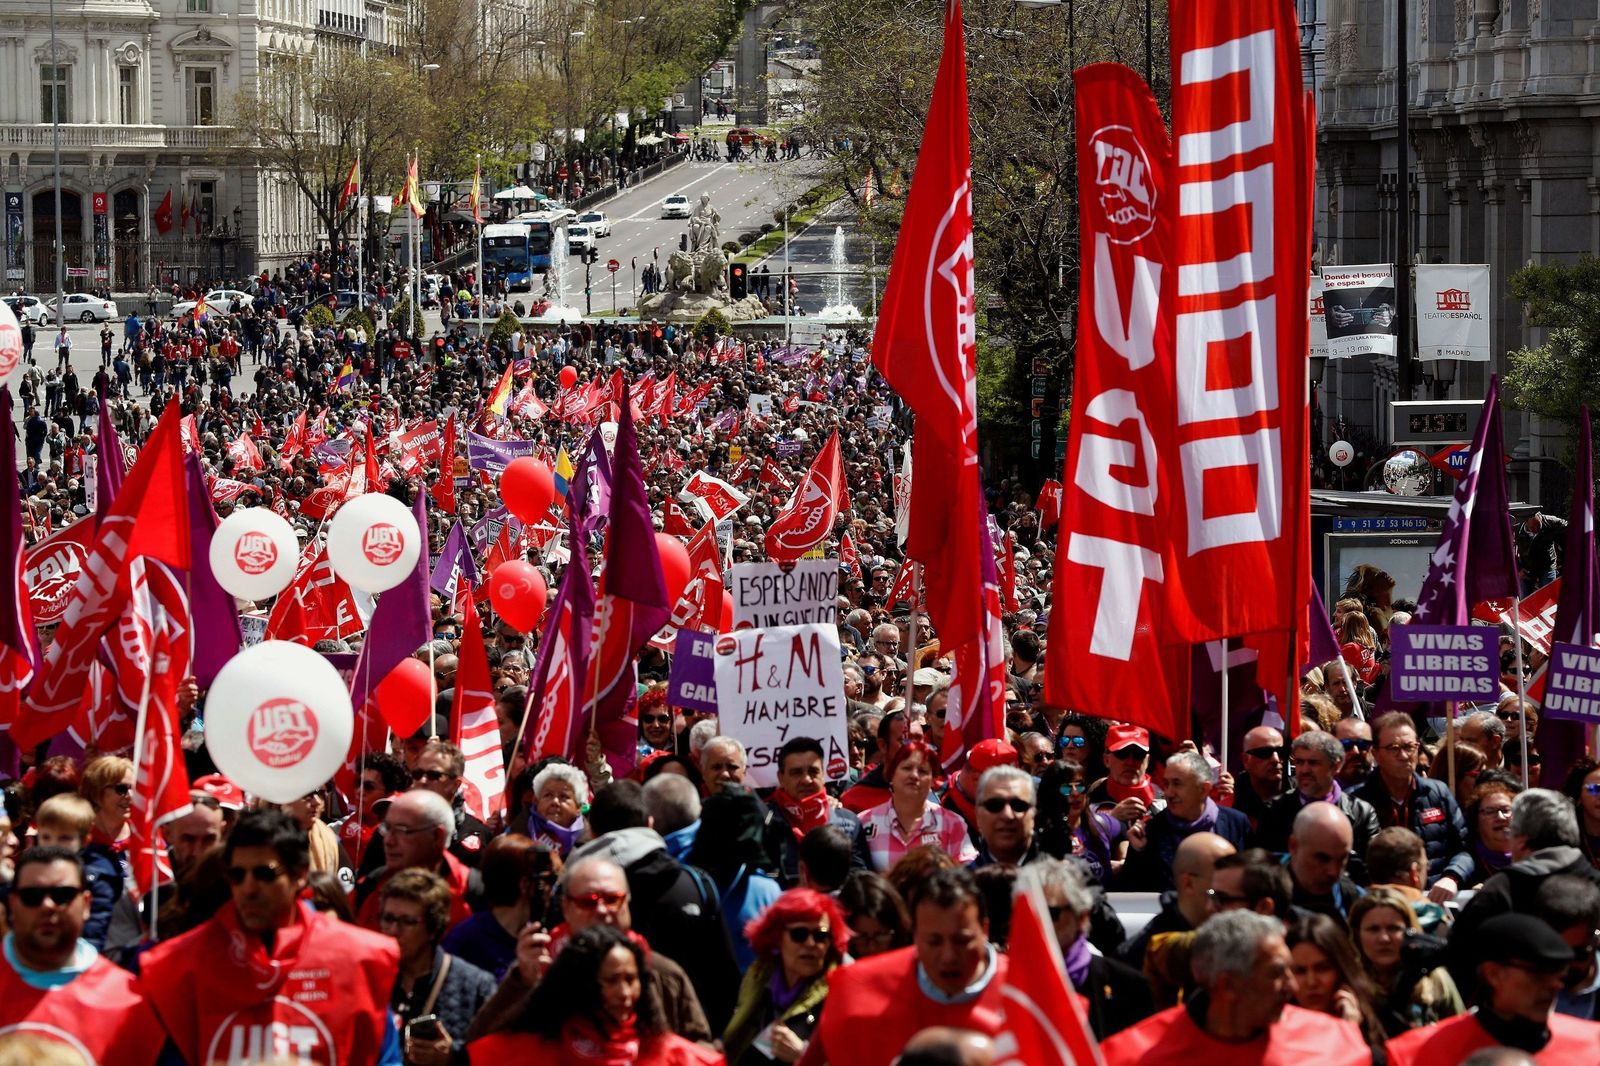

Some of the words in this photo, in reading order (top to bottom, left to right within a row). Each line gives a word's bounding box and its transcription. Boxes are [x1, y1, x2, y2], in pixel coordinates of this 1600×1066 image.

[1361, 271, 1392, 280] bosque
[1357, 344, 1373, 352] may
[1446, 349, 1470, 357] MADRID
[1337, 521, 1343, 529] 5
[1351, 520, 1356, 528] 9
[1362, 520, 1371, 528] 51
[1376, 519, 1385, 528] 52
[1389, 519, 1399, 528] 53
[1401, 519, 1413, 528] 146
[1415, 518, 1427, 527] 150
[239, 535, 274, 558] UGT
[366, 526, 400, 550] UGT
[739, 572, 838, 607] ESPERANDO
[1408, 633, 1484, 650] VIVAS
[1404, 655, 1489, 672] LIBRES
[1400, 676, 1493, 693] UNIDAS
[743, 695, 837, 724] HAMBRE
[254, 703, 307, 738] UGT
[776, 724, 790, 742] Y
